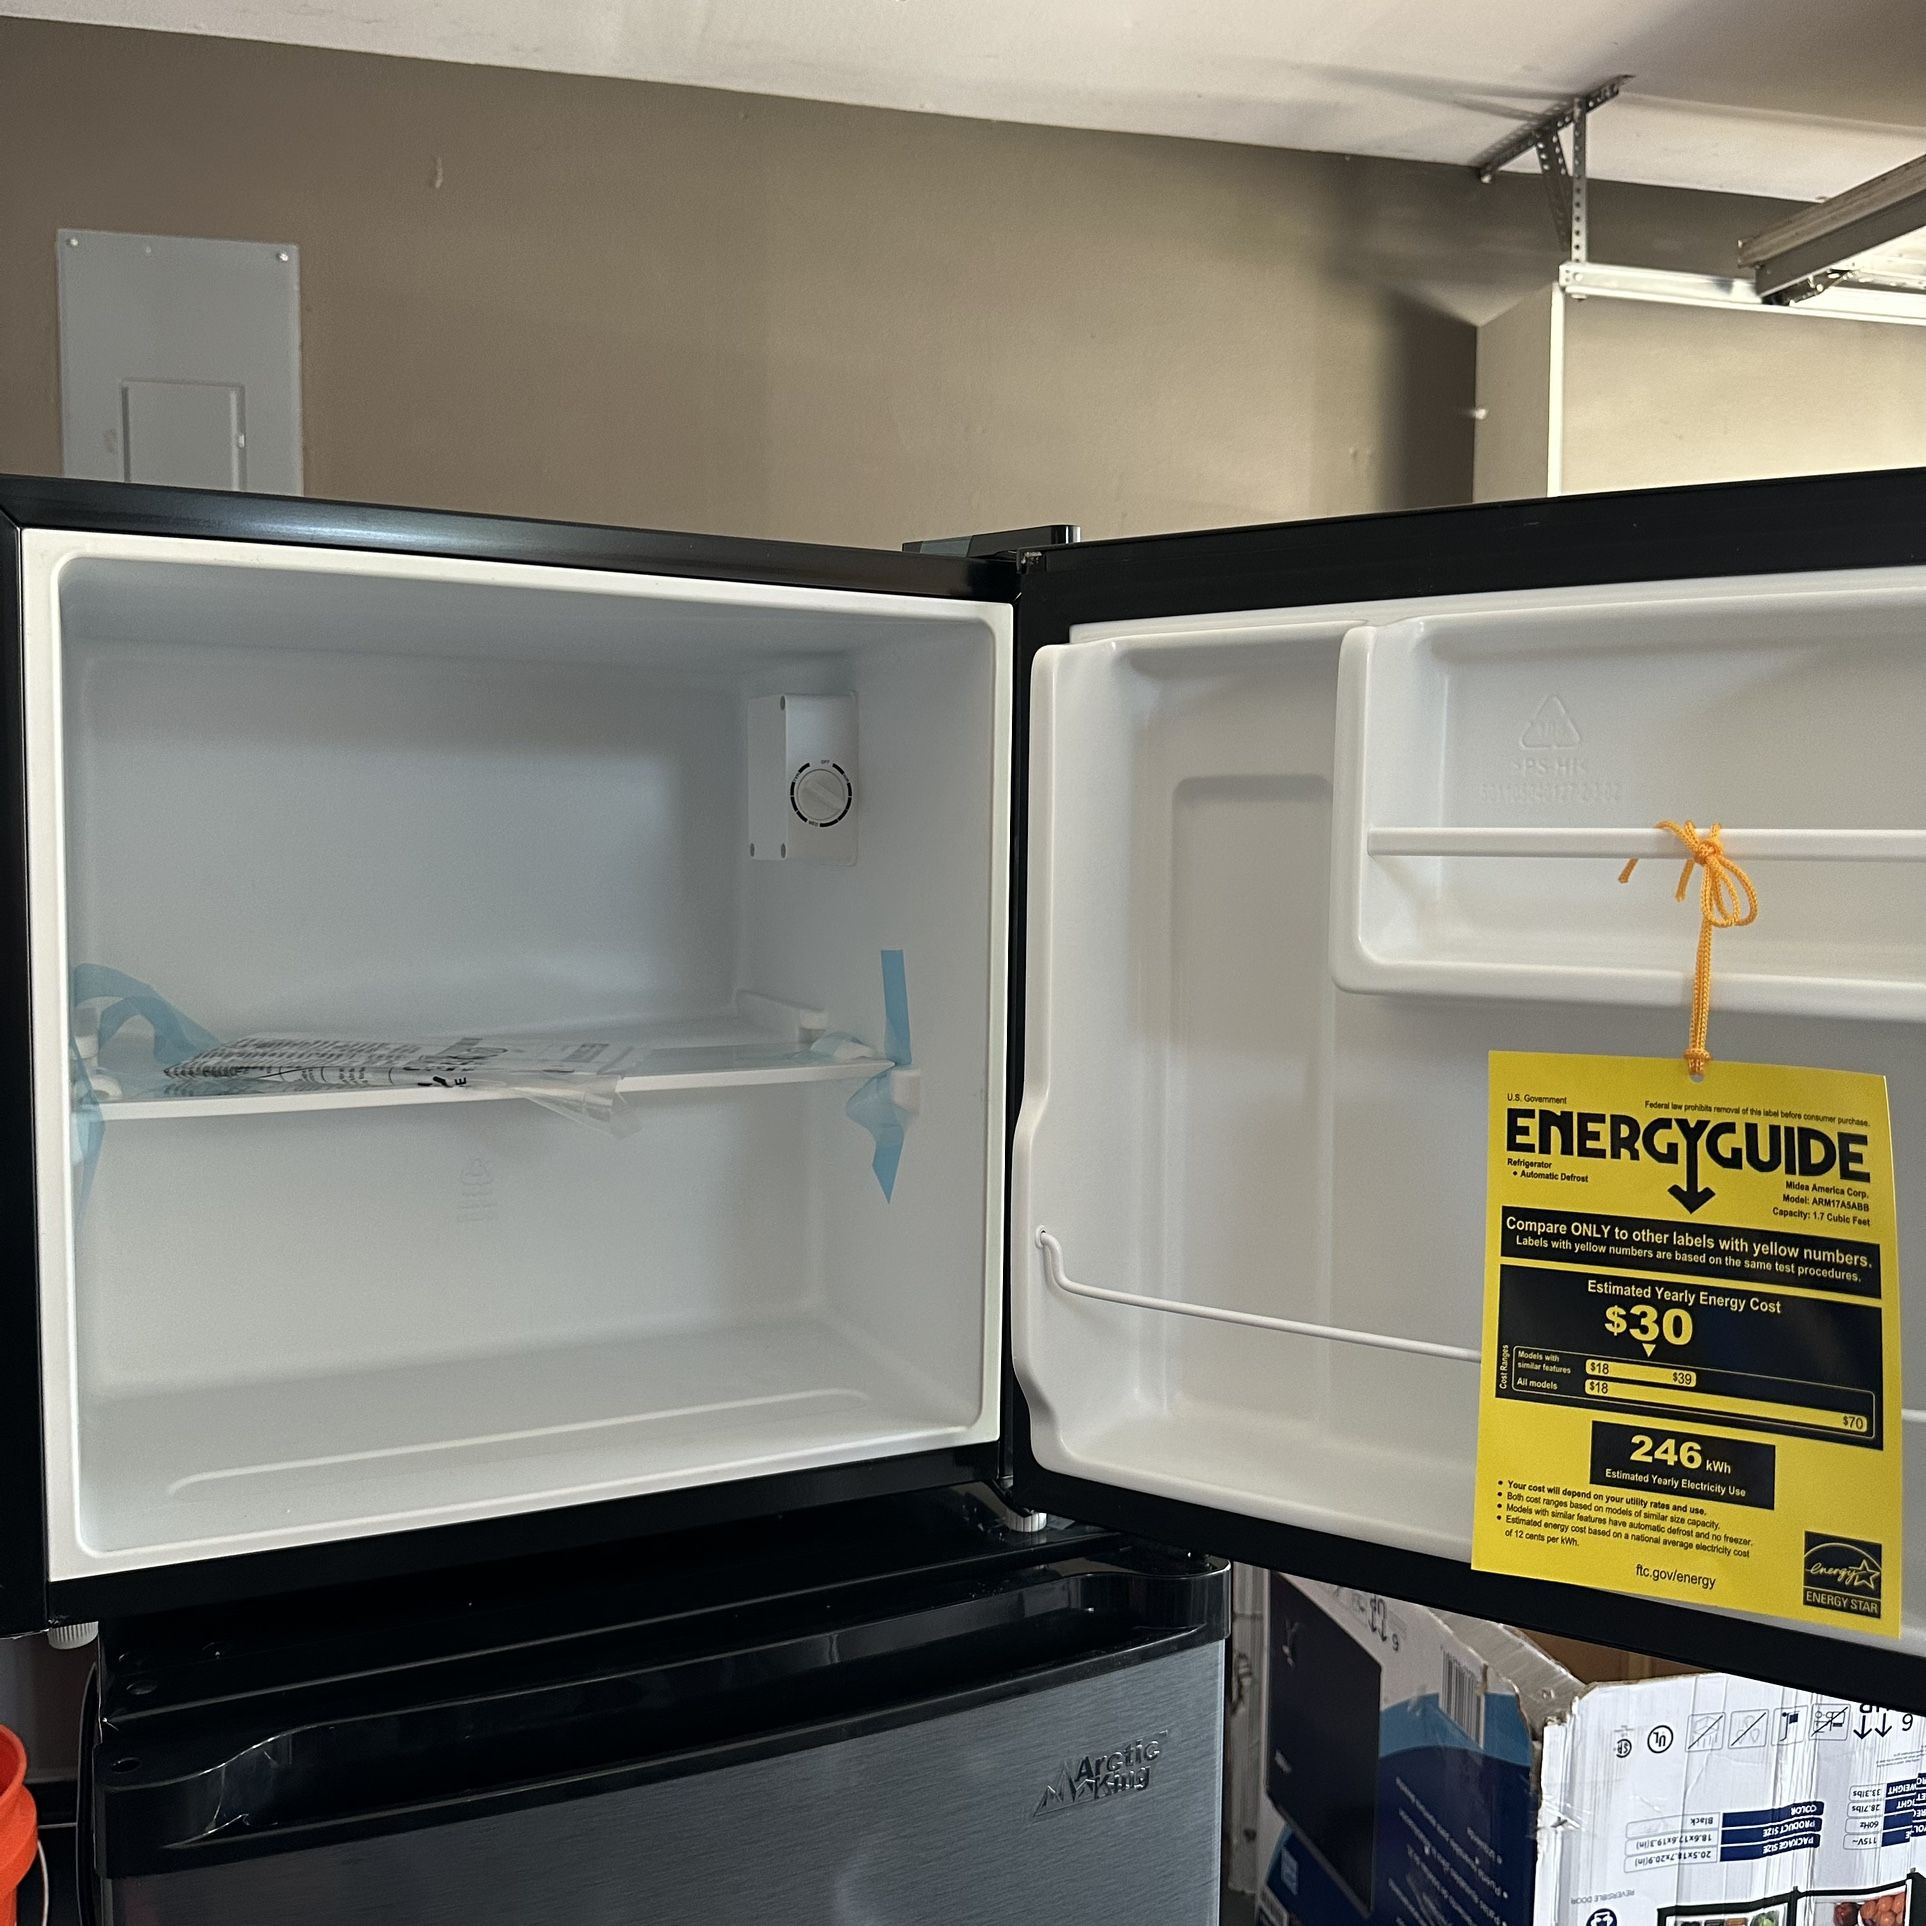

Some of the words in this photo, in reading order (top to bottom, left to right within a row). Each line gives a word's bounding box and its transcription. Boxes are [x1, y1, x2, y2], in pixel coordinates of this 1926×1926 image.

[1507, 1094, 1520, 1102] U.S.
[1524, 1094, 1567, 1104] Government
[1644, 1100, 1670, 1109] Federal
[1671, 1102, 1683, 1110] law
[1684, 1104, 1712, 1112] prohibits
[1713, 1106, 1740, 1114] removal
[1750, 1108, 1762, 1116] this
[1763, 1110, 1779, 1118] label
[1781, 1111, 1802, 1120] before
[1804, 1114, 1836, 1124] consumer
[1838, 1117, 1870, 1127] purchase.
[1507, 1108, 1870, 1183] ENERGYGUIDE
[1507, 1158, 1552, 1169] Refrigerator
[1520, 1170, 1559, 1180] Automatic
[1560, 1172, 1588, 1182] Defrost
[1783, 1194, 1810, 1205] Model:
[1786, 1180, 1810, 1192] Midea
[1812, 1184, 1845, 1195] America
[1846, 1188, 1869, 1199] Corp.
[1772, 1208, 1810, 1220] Capacity:
[1812, 1212, 1824, 1220] 1.7
[1826, 1214, 1850, 1224] Cubic
[1852, 1216, 1870, 1226] Feet
[1506, 1216, 1568, 1234] Compare
[1570, 1222, 1611, 1238] ONLY
[1614, 1227, 1628, 1240] to
[1632, 1229, 1670, 1244] other
[1673, 1232, 1714, 1248] labels
[1718, 1236, 1748, 1252] with
[1752, 1242, 1799, 1258] yellow
[1804, 1248, 1872, 1268] numbers.
[1516, 1235, 1548, 1248] Labels
[1551, 1239, 1572, 1250] with
[1574, 1242, 1606, 1253] yellow
[1609, 1246, 1654, 1258] numbers
[1656, 1252, 1672, 1260] are
[1675, 1250, 1706, 1263] based
[1709, 1256, 1722, 1265] on
[1725, 1256, 1741, 1267] the
[1744, 1260, 1772, 1270] same
[1775, 1262, 1795, 1274] test
[1798, 1266, 1862, 1283] procedures.
[1588, 1280, 1651, 1298] Estimated
[1655, 1286, 1696, 1306] Yearly
[1700, 1292, 1746, 1312] Energy
[1750, 1298, 1782, 1314] Cost
[1604, 1304, 1693, 1346] $30
[1500, 1344, 1510, 1370] Ranges
[1518, 1350, 1542, 1362] Models
[1544, 1354, 1560, 1362] with
[1518, 1361, 1541, 1370] similar
[1542, 1364, 1571, 1374] features
[1590, 1362, 1609, 1375] $18
[1672, 1372, 1692, 1386] $39
[1499, 1372, 1508, 1390] Cost
[1517, 1377, 1528, 1386] All
[1530, 1378, 1558, 1390] models
[1589, 1381, 1608, 1394] $18
[1843, 1416, 1863, 1430] $70
[1630, 1434, 1702, 1469] 246
[1706, 1460, 1731, 1474] kWh
[1606, 1468, 1649, 1483] Estimated
[1652, 1475, 1679, 1488] Yearly
[1682, 1479, 1726, 1496] Electricity
[1728, 1486, 1746, 1496] Use
[1508, 1480, 1526, 1490] Your
[1528, 1484, 1545, 1493] cost
[1547, 1486, 1560, 1494] will
[1562, 1488, 1592, 1499] depend
[1606, 1495, 1624, 1504] your
[1626, 1497, 1648, 1508] utility
[1650, 1501, 1670, 1510] rates
[1672, 1504, 1688, 1512] and
[1690, 1507, 1706, 1516] use.
[1507, 1492, 1524, 1502] Both
[1526, 1495, 1541, 1504] cost
[1542, 1498, 1568, 1508] ranges
[1570, 1501, 1592, 1511] based
[1606, 1506, 1632, 1516] models
[1644, 1511, 1668, 1522] similar
[1670, 1515, 1685, 1524] size
[1687, 1518, 1720, 1530] capacity.
[1506, 1504, 1532, 1514] Models
[1534, 1508, 1549, 1516] with
[1551, 1510, 1575, 1520] similar
[1577, 1512, 1606, 1524] features
[1608, 1518, 1627, 1528] have
[1629, 1521, 1666, 1533] automatic
[1667, 1526, 1694, 1538] defrost
[1696, 1531, 1710, 1540] and
[1724, 1534, 1752, 1546] freezer.
[1506, 1515, 1542, 1528] Estimated
[1544, 1521, 1568, 1533] energy
[1571, 1525, 1586, 1534] cost
[1588, 1526, 1610, 1537] based
[1624, 1532, 1629, 1540] a
[1631, 1533, 1660, 1544] national
[1662, 1538, 1694, 1550] average
[1696, 1542, 1732, 1556] electricity
[1733, 1548, 1750, 1558] cost
[1515, 1530, 1524, 1538] 12
[1525, 1532, 1545, 1542] cents
[1547, 1536, 1559, 1544] per
[1560, 1536, 1580, 1546] kWh.
[1636, 1564, 1716, 1590] ftc.gov/energy
[1810, 1562, 1856, 1586] energy
[1806, 1591, 1848, 1607] ENERGY
[1851, 1598, 1878, 1613] STAR
[1075, 1741, 1160, 1781] Arctic
[1852, 1788, 1881, 1798] 33.3lbs
[1792, 1804, 1816, 1815] COLOR
[1852, 1804, 1880, 1812] 28.7lbs
[1762, 1827, 1778, 1838] SIZE
[1780, 1820, 1816, 1834] PRODUCT
[1860, 1820, 1878, 1829] 60Hz
[1762, 1844, 1778, 1855] SIZE
[1780, 1836, 1814, 1850] PACKAGE
